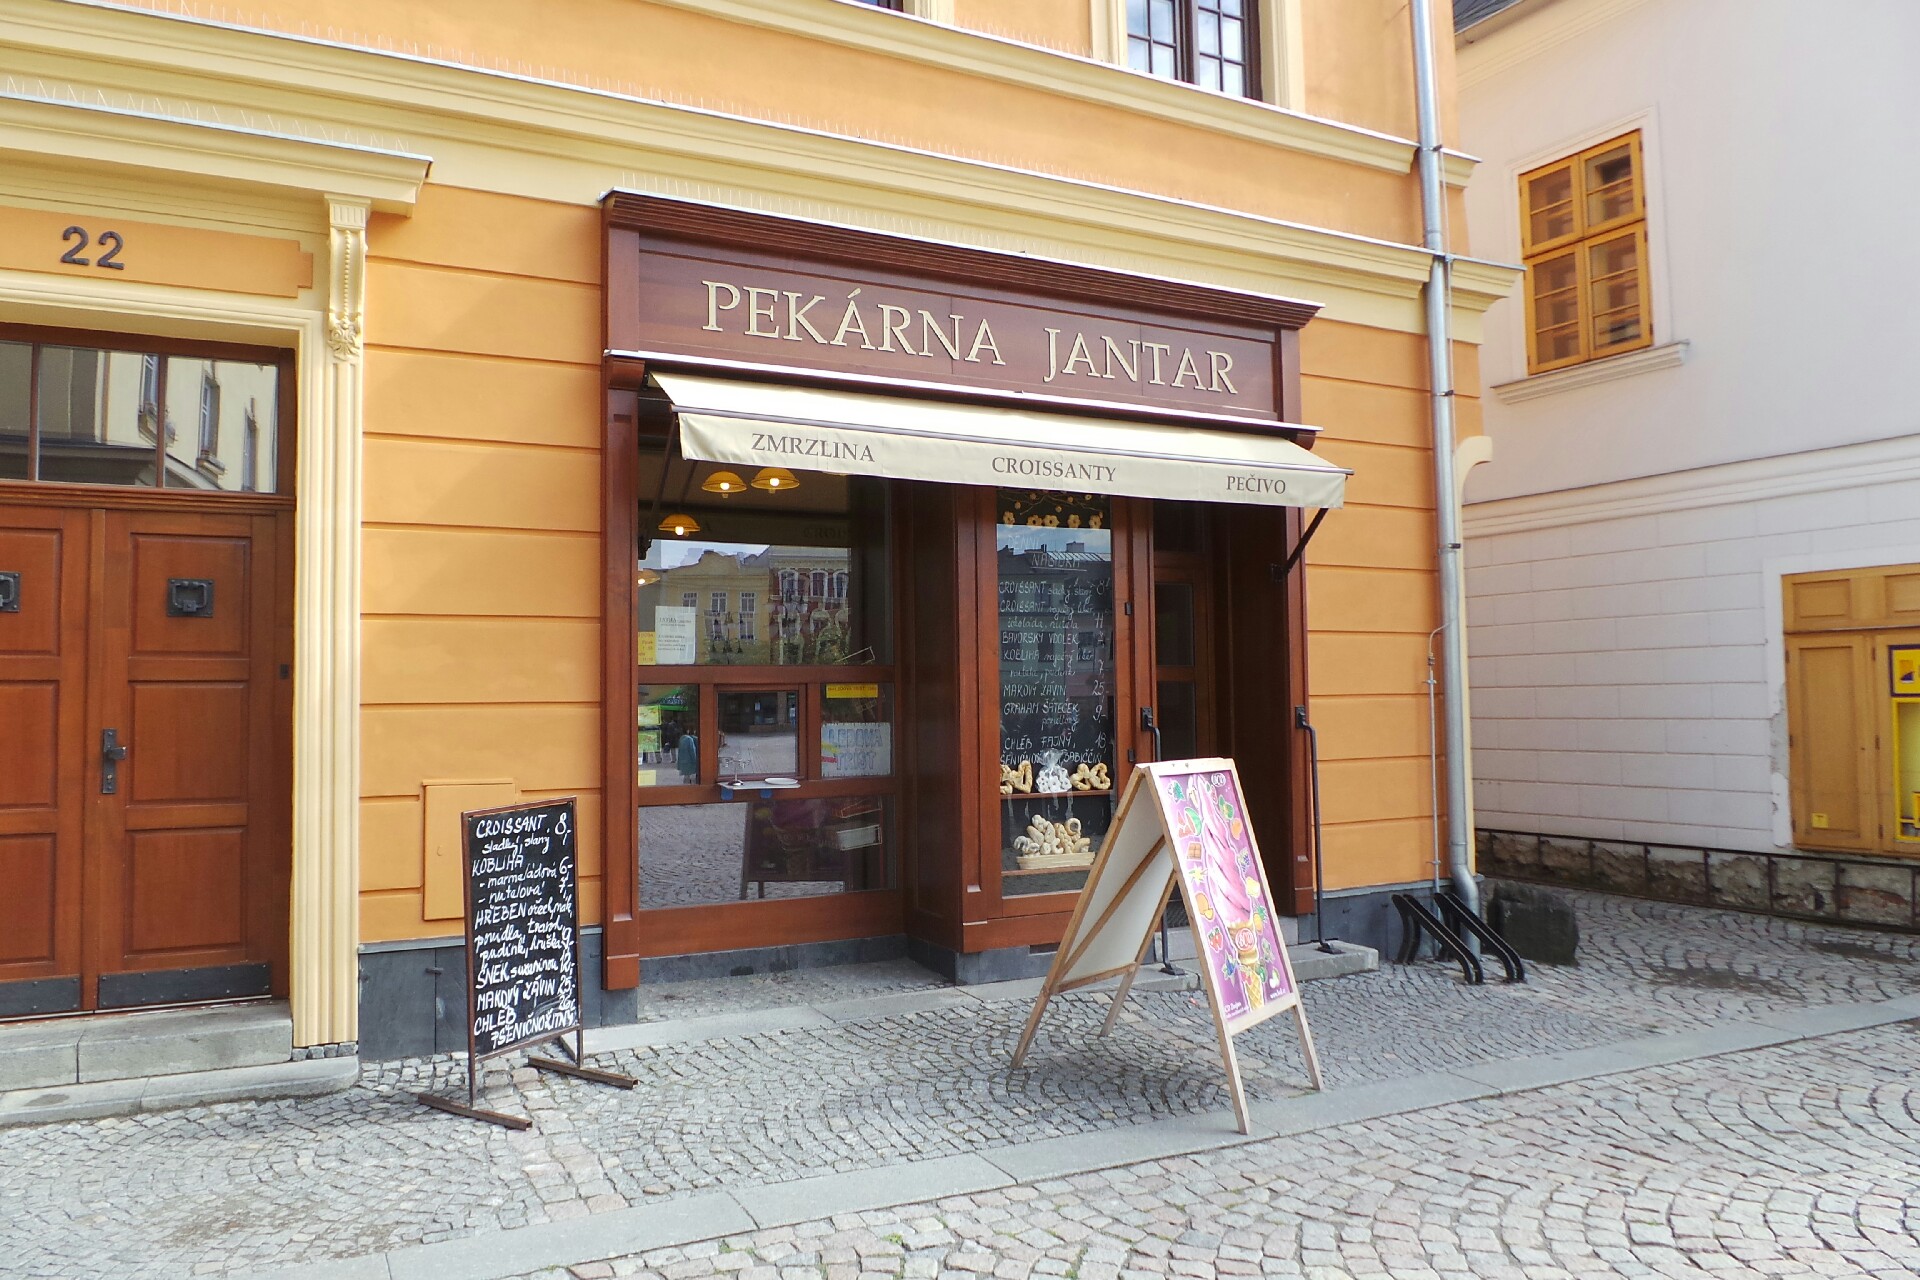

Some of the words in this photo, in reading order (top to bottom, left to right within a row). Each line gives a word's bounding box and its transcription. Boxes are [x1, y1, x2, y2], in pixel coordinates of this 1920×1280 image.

[61, 226, 125, 271] 22
[701, 280, 1006, 366] PEKÁRNA
[1043, 327, 1238, 395] JANTAR
[751, 432, 875, 462] ZMRZLINA
[992, 456, 1116, 482] CROISSANTY
[1226, 472, 1286, 495] PEČIVO
[1003, 681, 1039, 697] MAKOVÝ
[1040, 681, 1066, 697] ZÁVIN
[1003, 702, 1039, 716] GRAHAM
[476, 814, 547, 838] CROISSANT
[471, 854, 524, 877] KOBLIHA
[474, 902, 528, 931] HŘEBEN
[477, 979, 524, 1012] MAKOVÝ
[522, 974, 555, 1009] ZÁVIN
